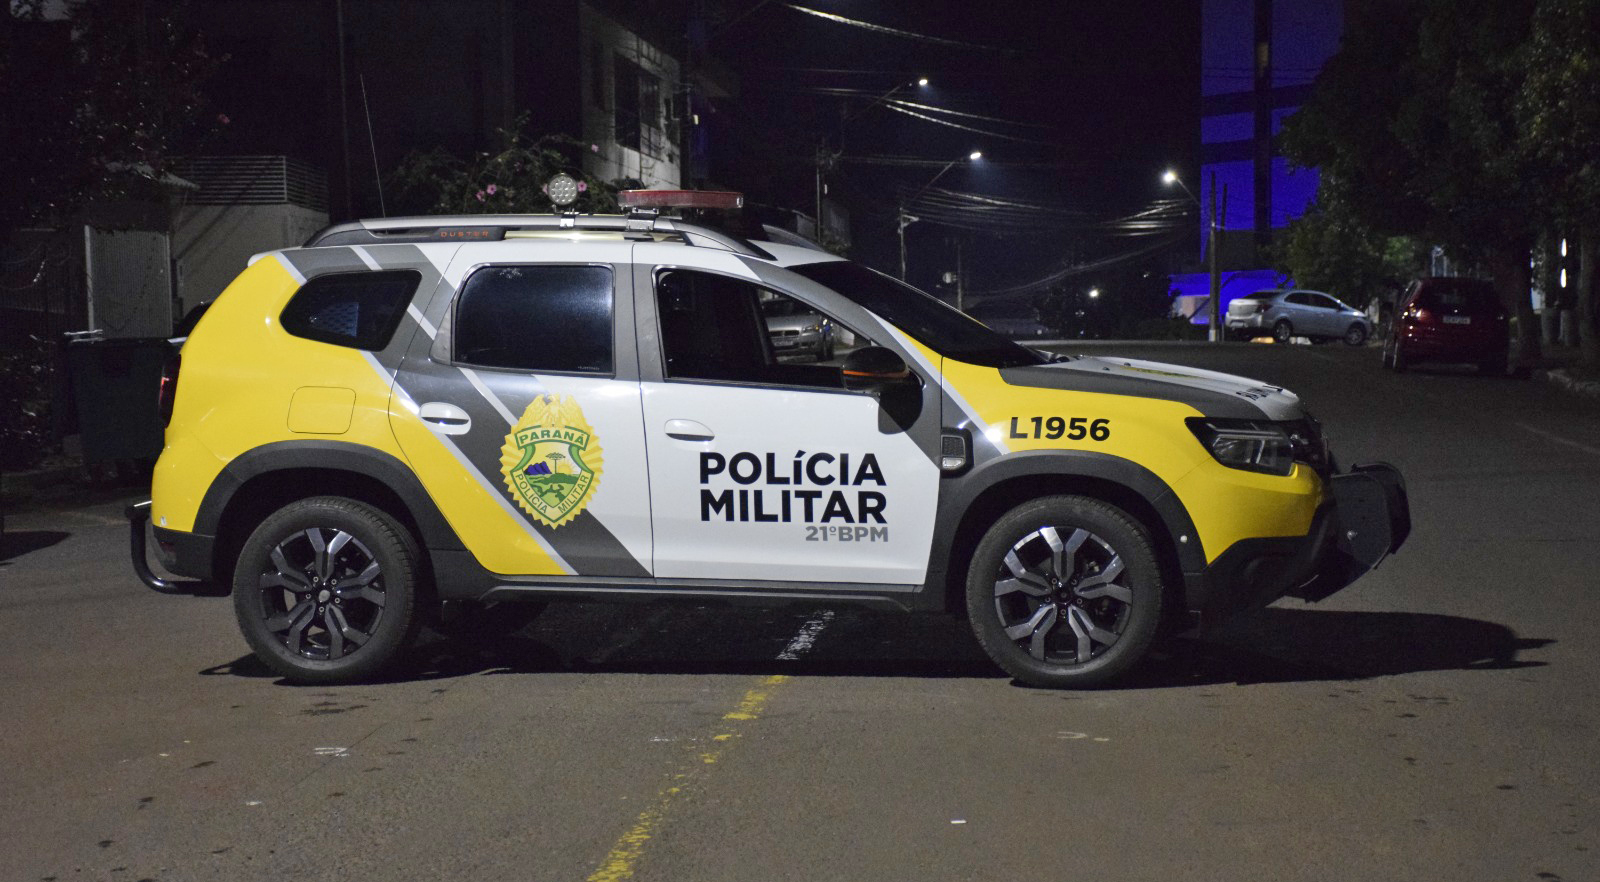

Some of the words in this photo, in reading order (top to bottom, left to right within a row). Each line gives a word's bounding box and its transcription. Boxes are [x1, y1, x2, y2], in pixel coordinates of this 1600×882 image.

[519, 429, 585, 446] PARANÁ
[1009, 416, 1111, 442] L1956
[515, 474, 548, 514] POLICIA
[557, 474, 590, 514] MILITAR
[700, 489, 888, 524] MILITAR
